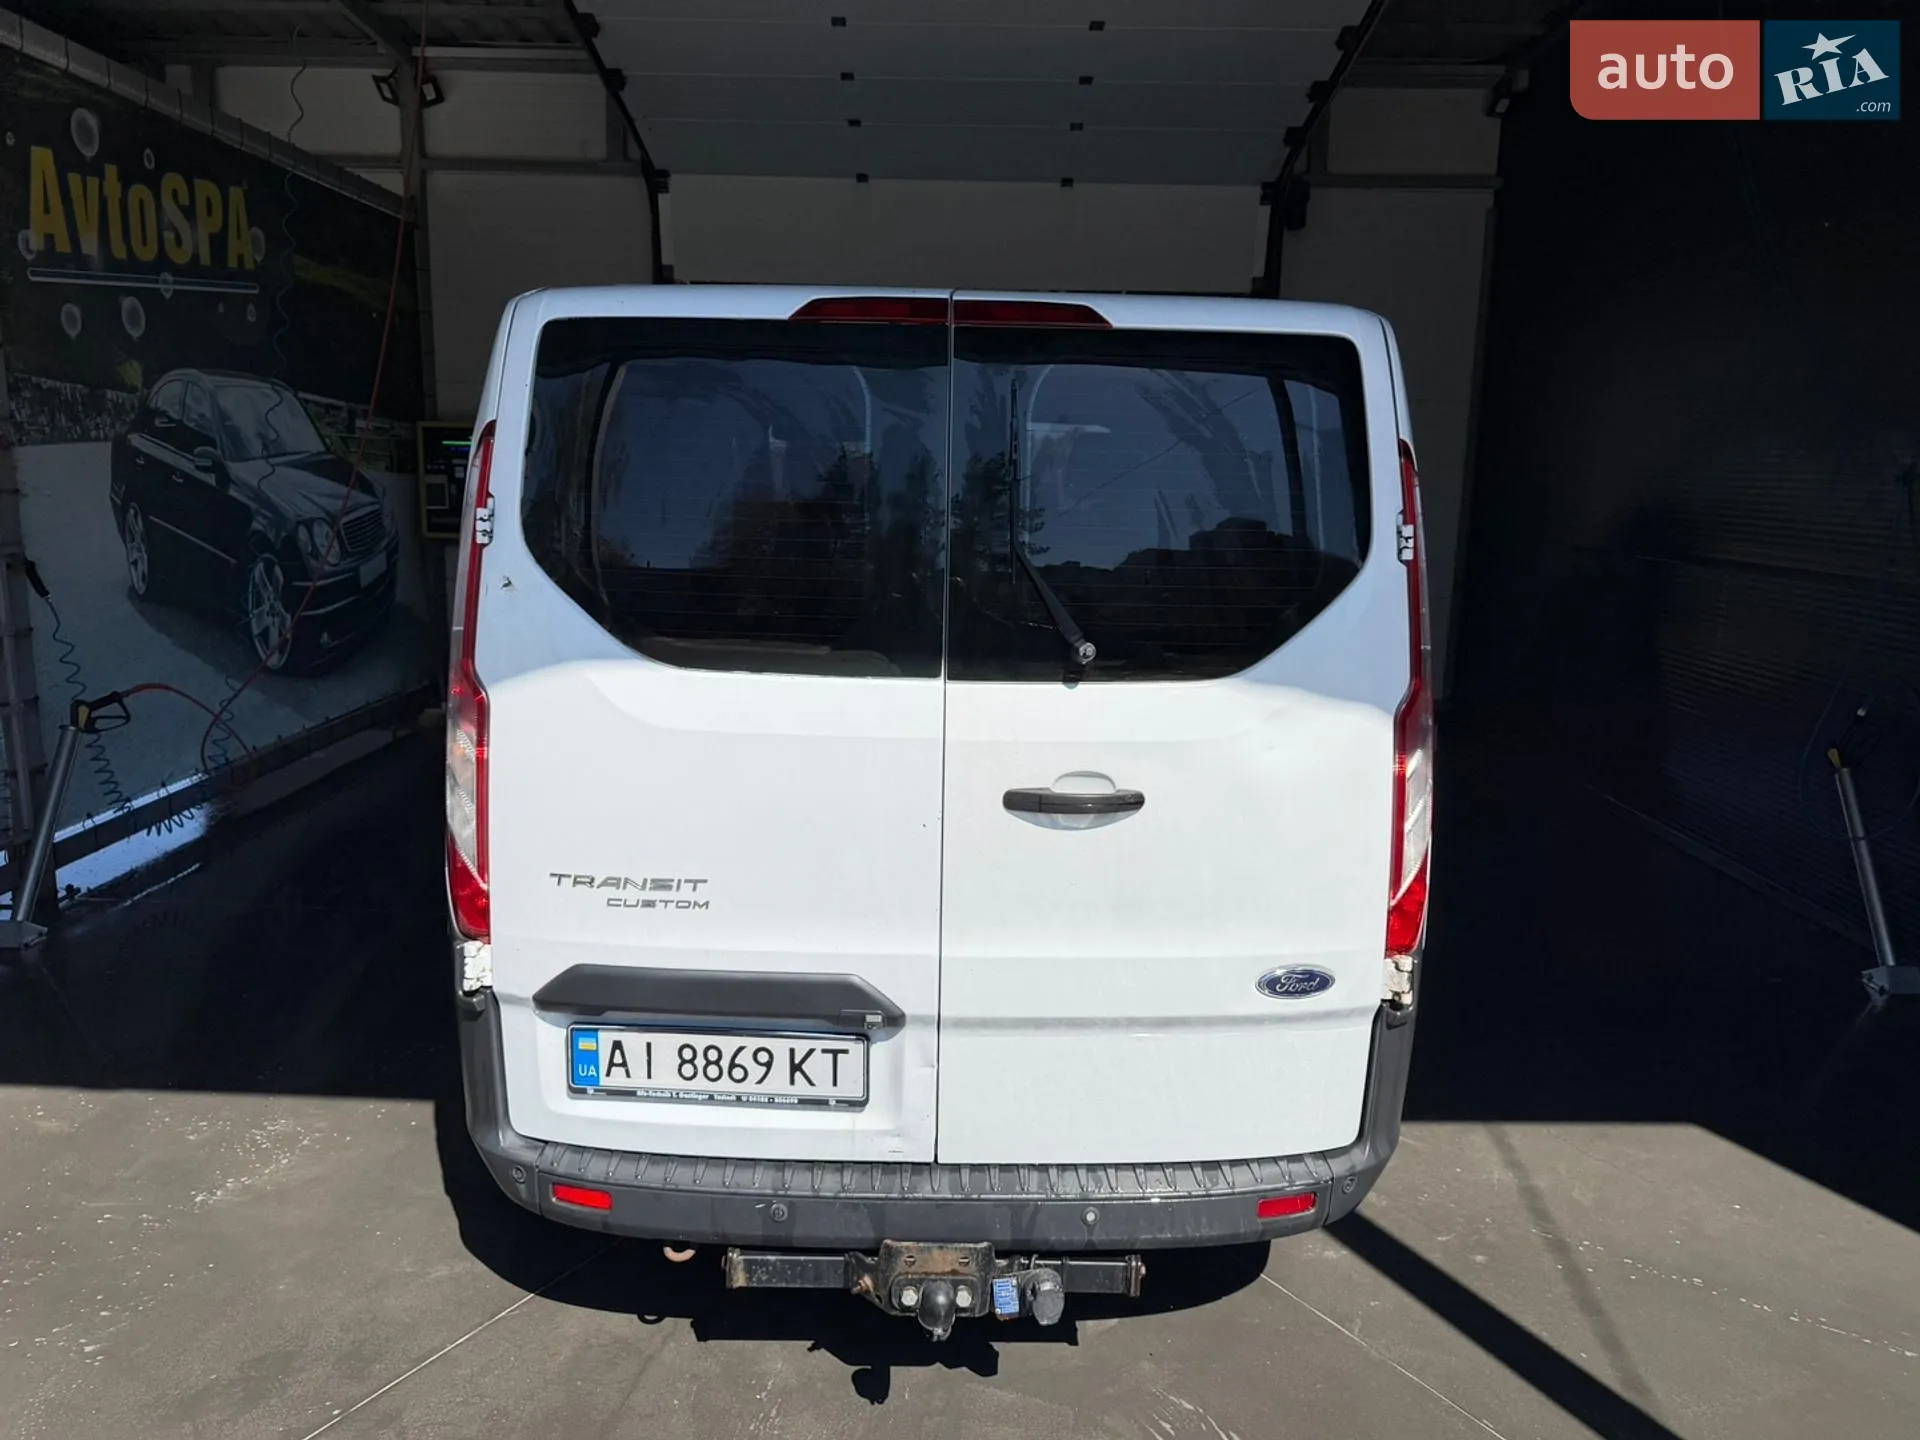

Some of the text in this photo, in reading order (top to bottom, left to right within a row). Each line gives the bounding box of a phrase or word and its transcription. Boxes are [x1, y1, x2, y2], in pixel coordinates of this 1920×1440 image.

[29, 145, 256, 270] AvtoSPA
[549, 872, 708, 893] TRANSIT
[606, 898, 710, 910] CUSTOM
[1275, 973, 1321, 993] Ford
[578, 1064, 598, 1077] UA
[605, 1039, 850, 1088] AI 8869 KT
